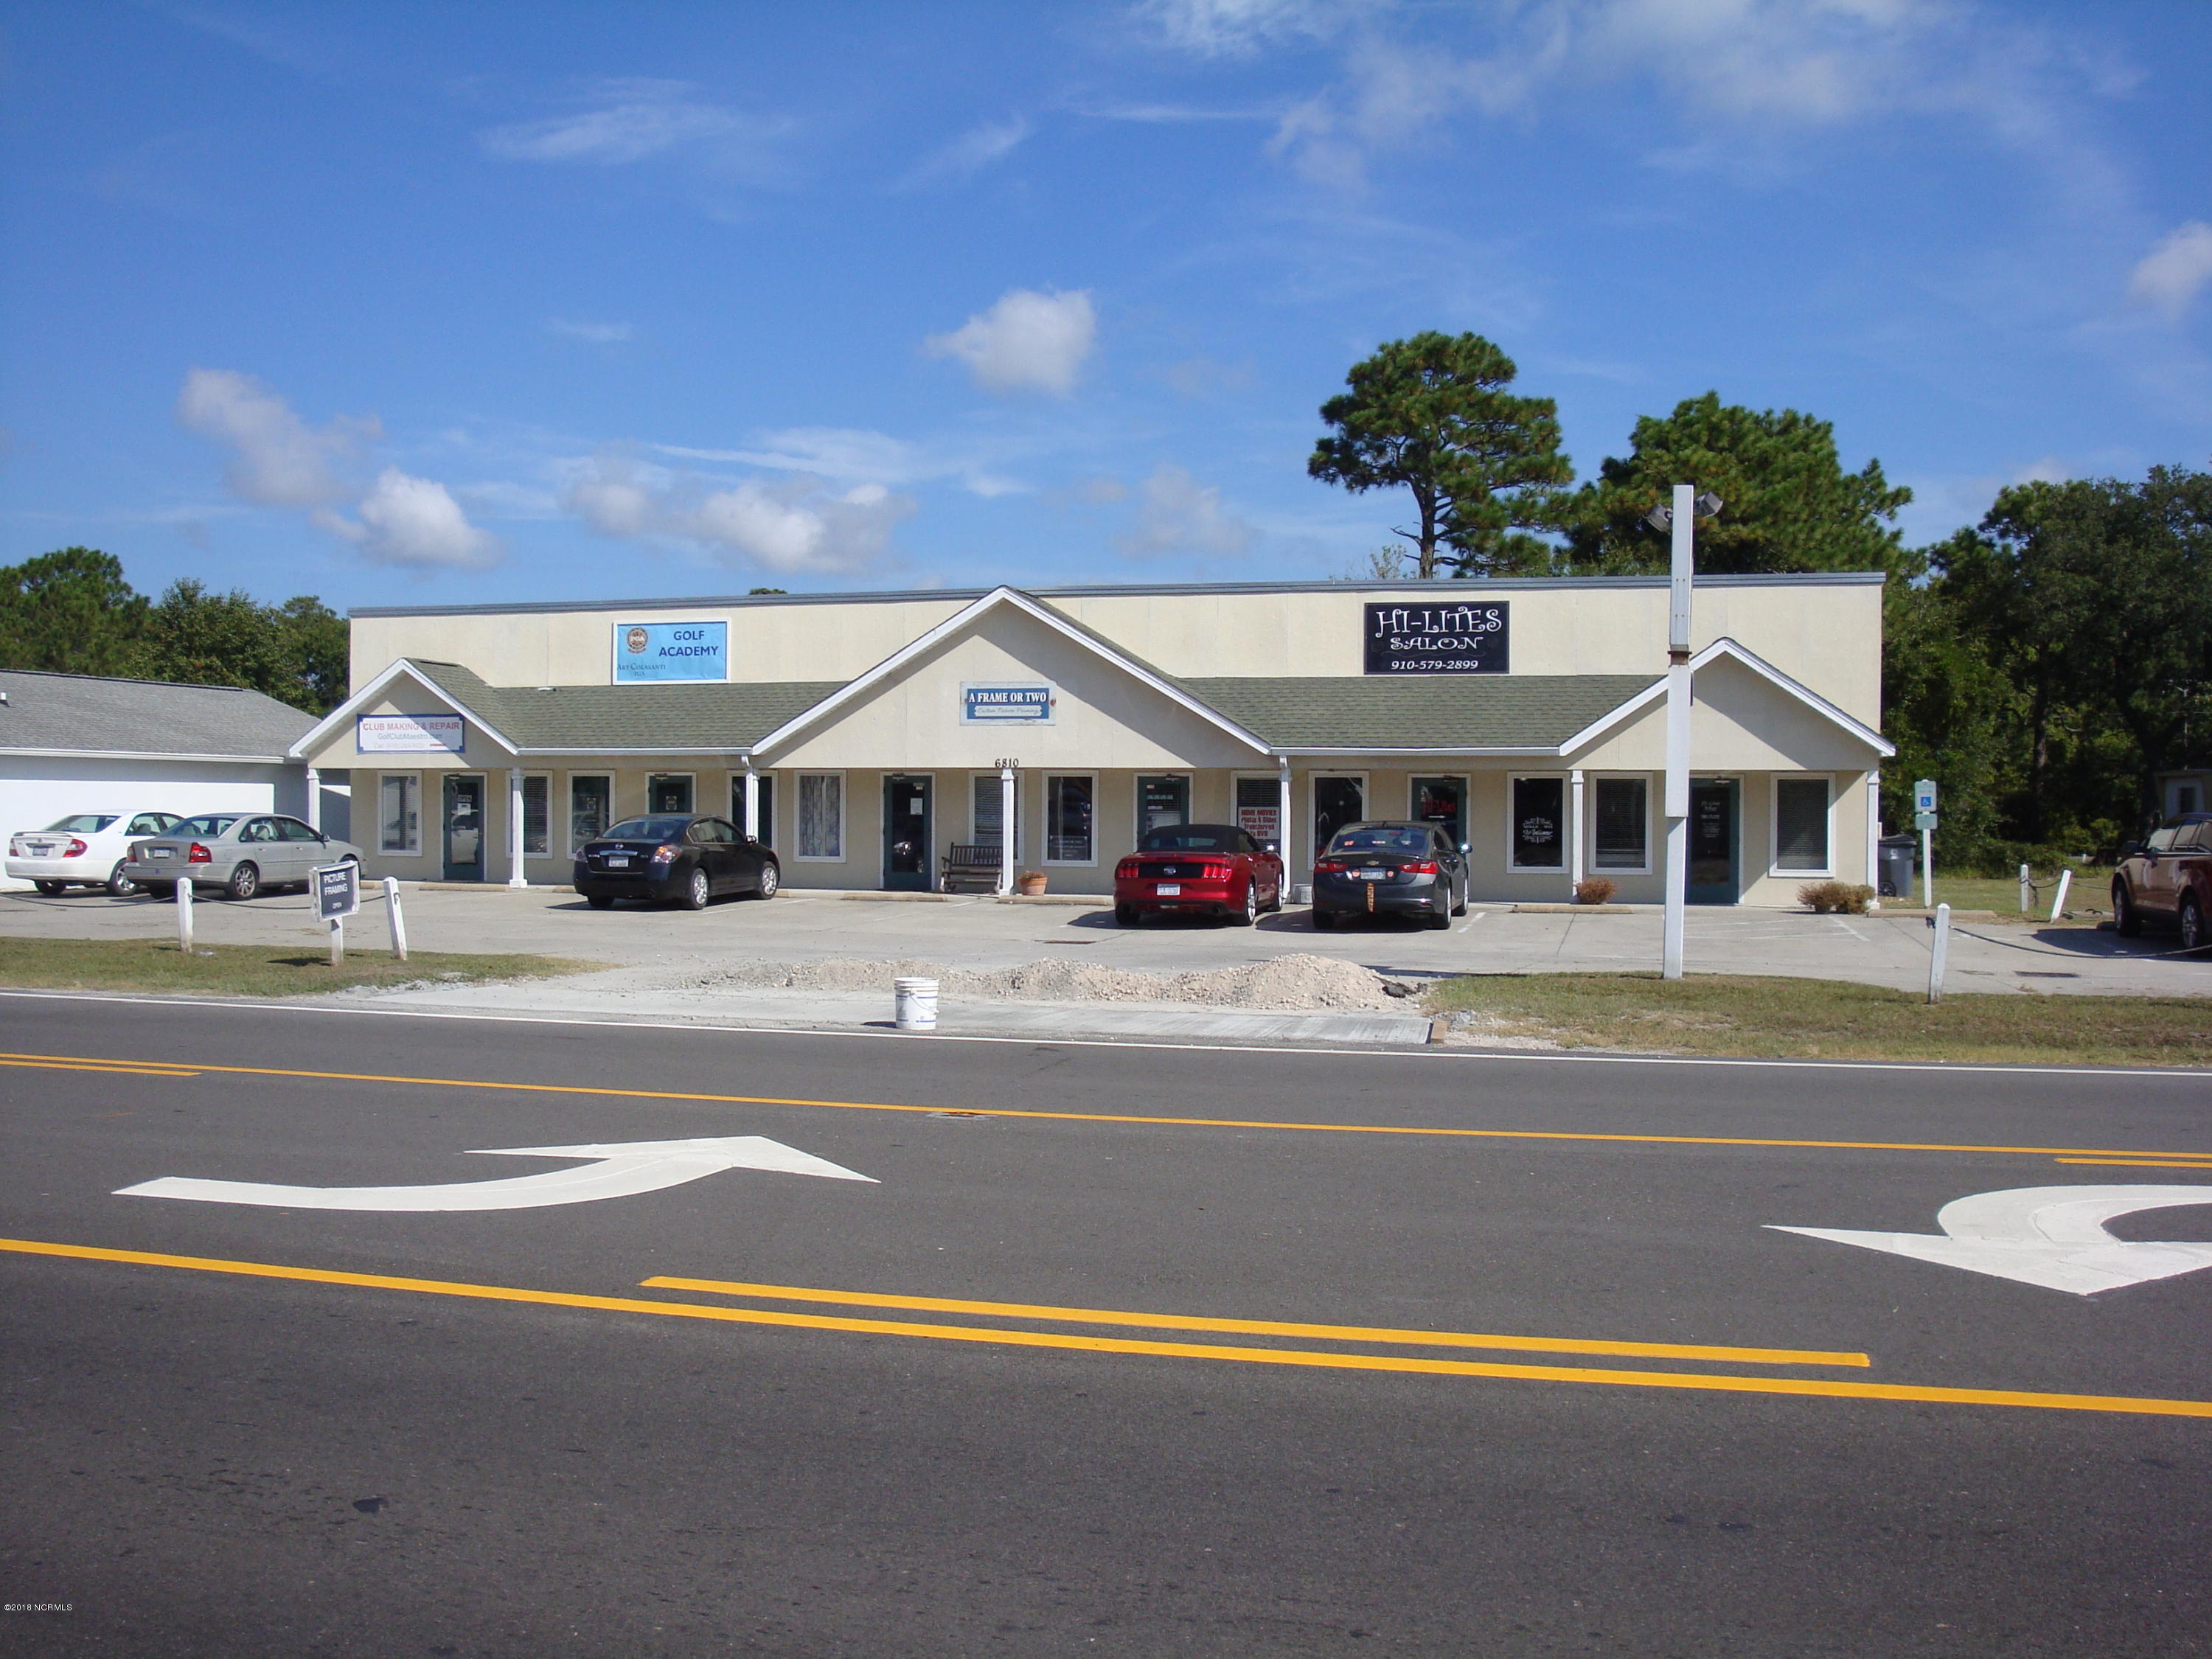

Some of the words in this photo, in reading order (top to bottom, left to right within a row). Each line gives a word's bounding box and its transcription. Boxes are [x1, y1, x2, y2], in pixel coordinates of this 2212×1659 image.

[1375, 606, 1502, 639] HI-LITES
[673, 630, 704, 641] GOLF
[1390, 637, 1484, 650] SALON
[658, 646, 719, 656] ACADEMY
[1391, 660, 1478, 670] 910-579-2899
[969, 692, 975, 703] A
[978, 692, 1008, 703] FRAME
[1010, 692, 1023, 702] OR
[1026, 692, 1047, 702] TWO
[363, 723, 385, 731] CLUB
[387, 722, 419, 730] MAKING
[429, 722, 459, 730] REPAIR
[995, 758, 1019, 768] 6810
[324, 872, 347, 884] PICTURE
[324, 883, 348, 896] FRAMING
